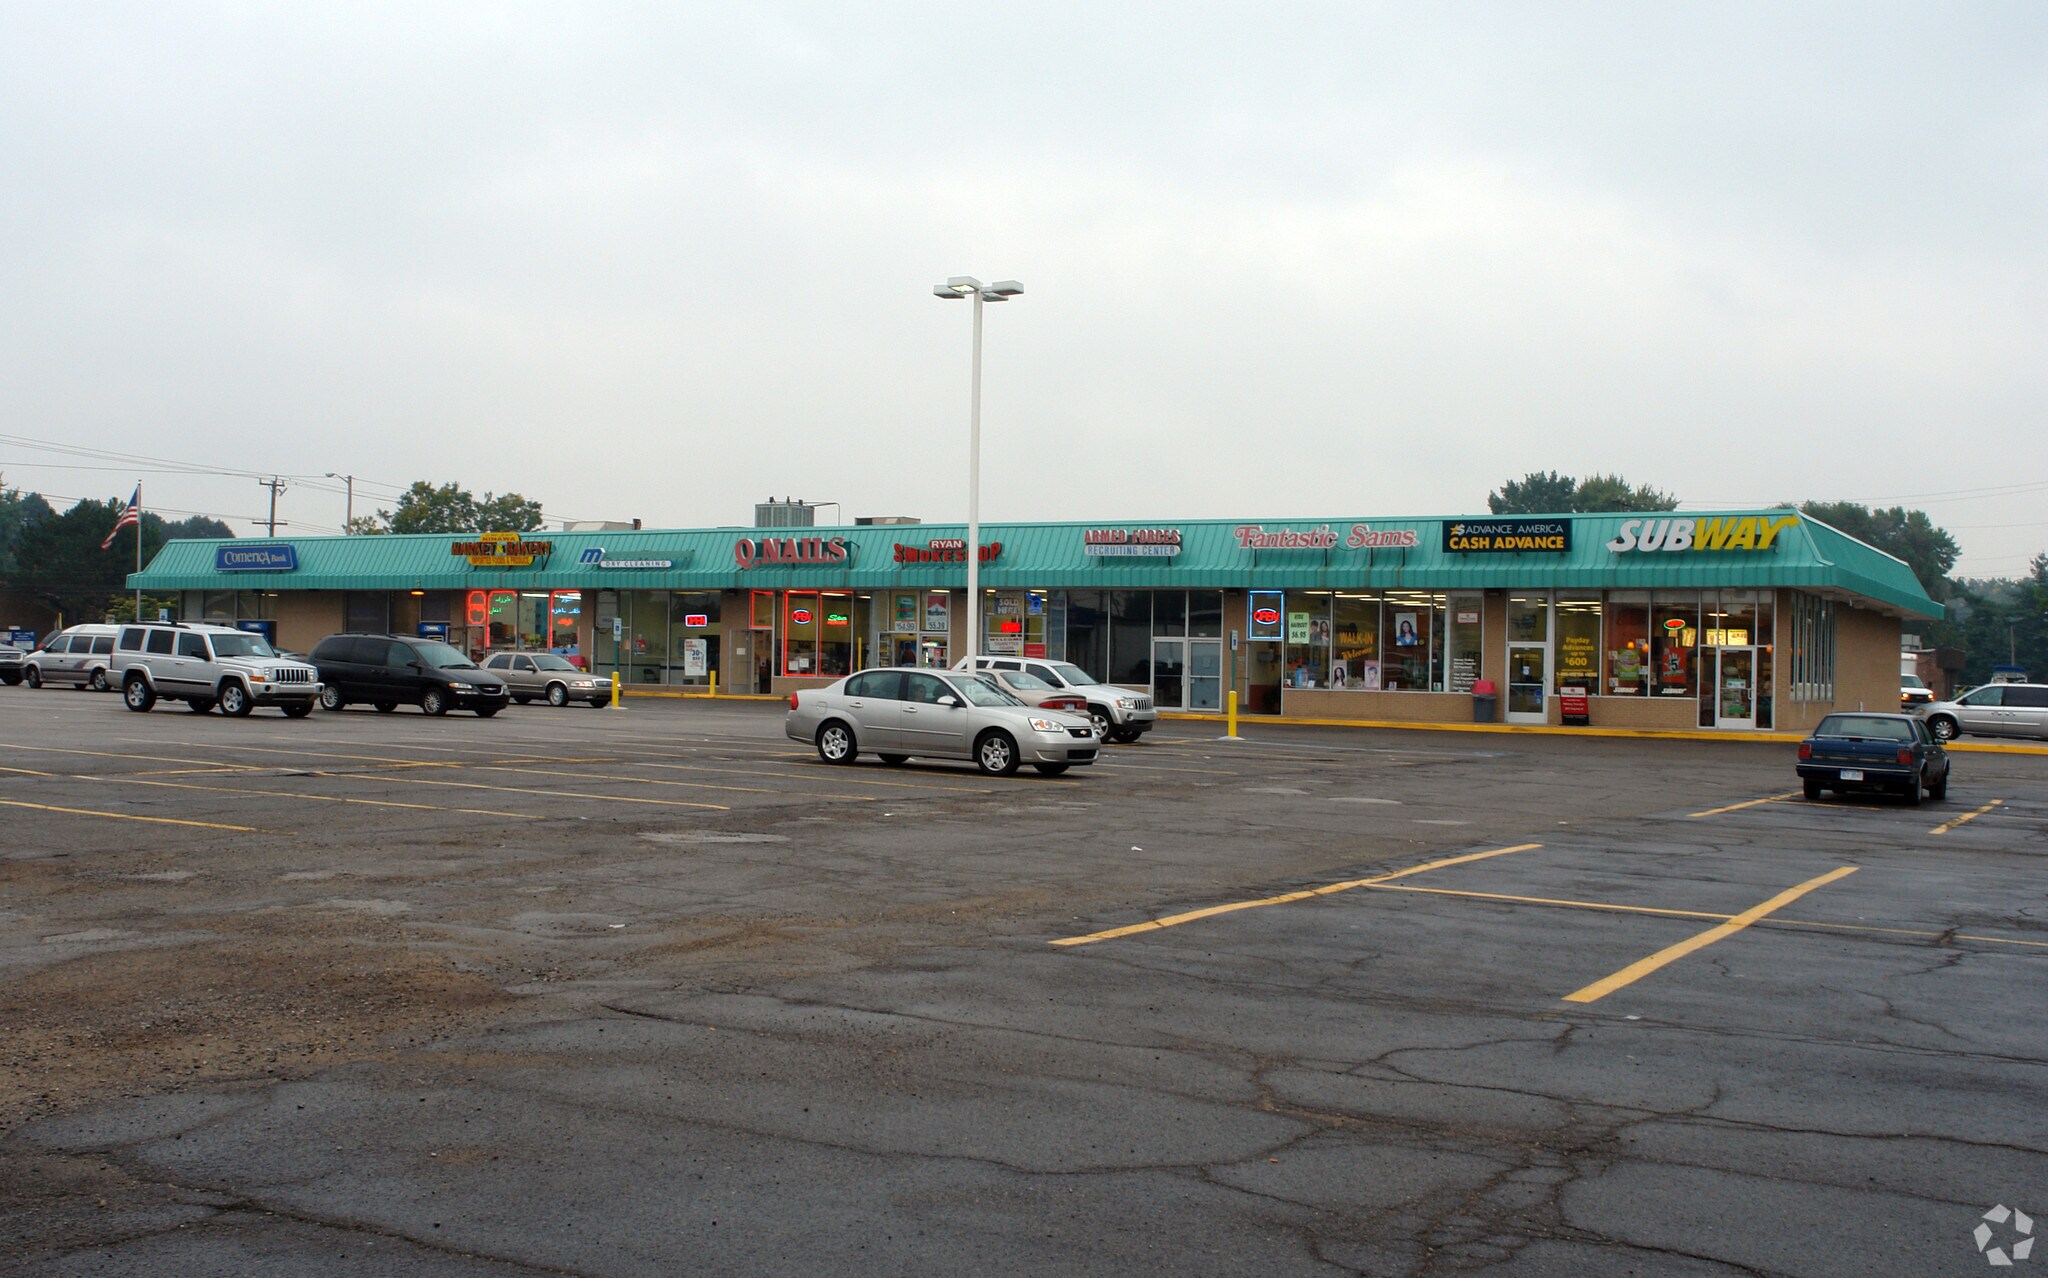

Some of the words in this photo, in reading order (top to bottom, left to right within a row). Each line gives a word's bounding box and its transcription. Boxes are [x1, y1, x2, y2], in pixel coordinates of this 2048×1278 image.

[1465, 525, 1513, 534] ADVANCE
[1517, 524, 1564, 534] AMERICA
[1605, 513, 1800, 552] SUBWAY
[1084, 529, 1127, 543] ARMED
[1132, 529, 1179, 544] FORCES
[1234, 524, 1338, 549] Fantastic
[1346, 524, 1416, 548] Sams
[1449, 536, 1490, 550] CASH
[1493, 536, 1564, 549] ADVANCE
[451, 542, 497, 556] MARKET
[505, 541, 553, 556] BAKERY
[931, 540, 962, 549] RYAN
[1087, 545, 1138, 555] RECRUITING
[1142, 545, 1175, 555] CENTER
[893, 541, 1001, 563] SMOKESOP
[791, 611, 813, 621] OPEN
[1253, 610, 1280, 622] OPEN
[1339, 631, 1374, 645] WALK-IN
[1565, 637, 1591, 645] Payday
[1341, 647, 1373, 661] Welcome
[1565, 657, 1588, 666] $600
